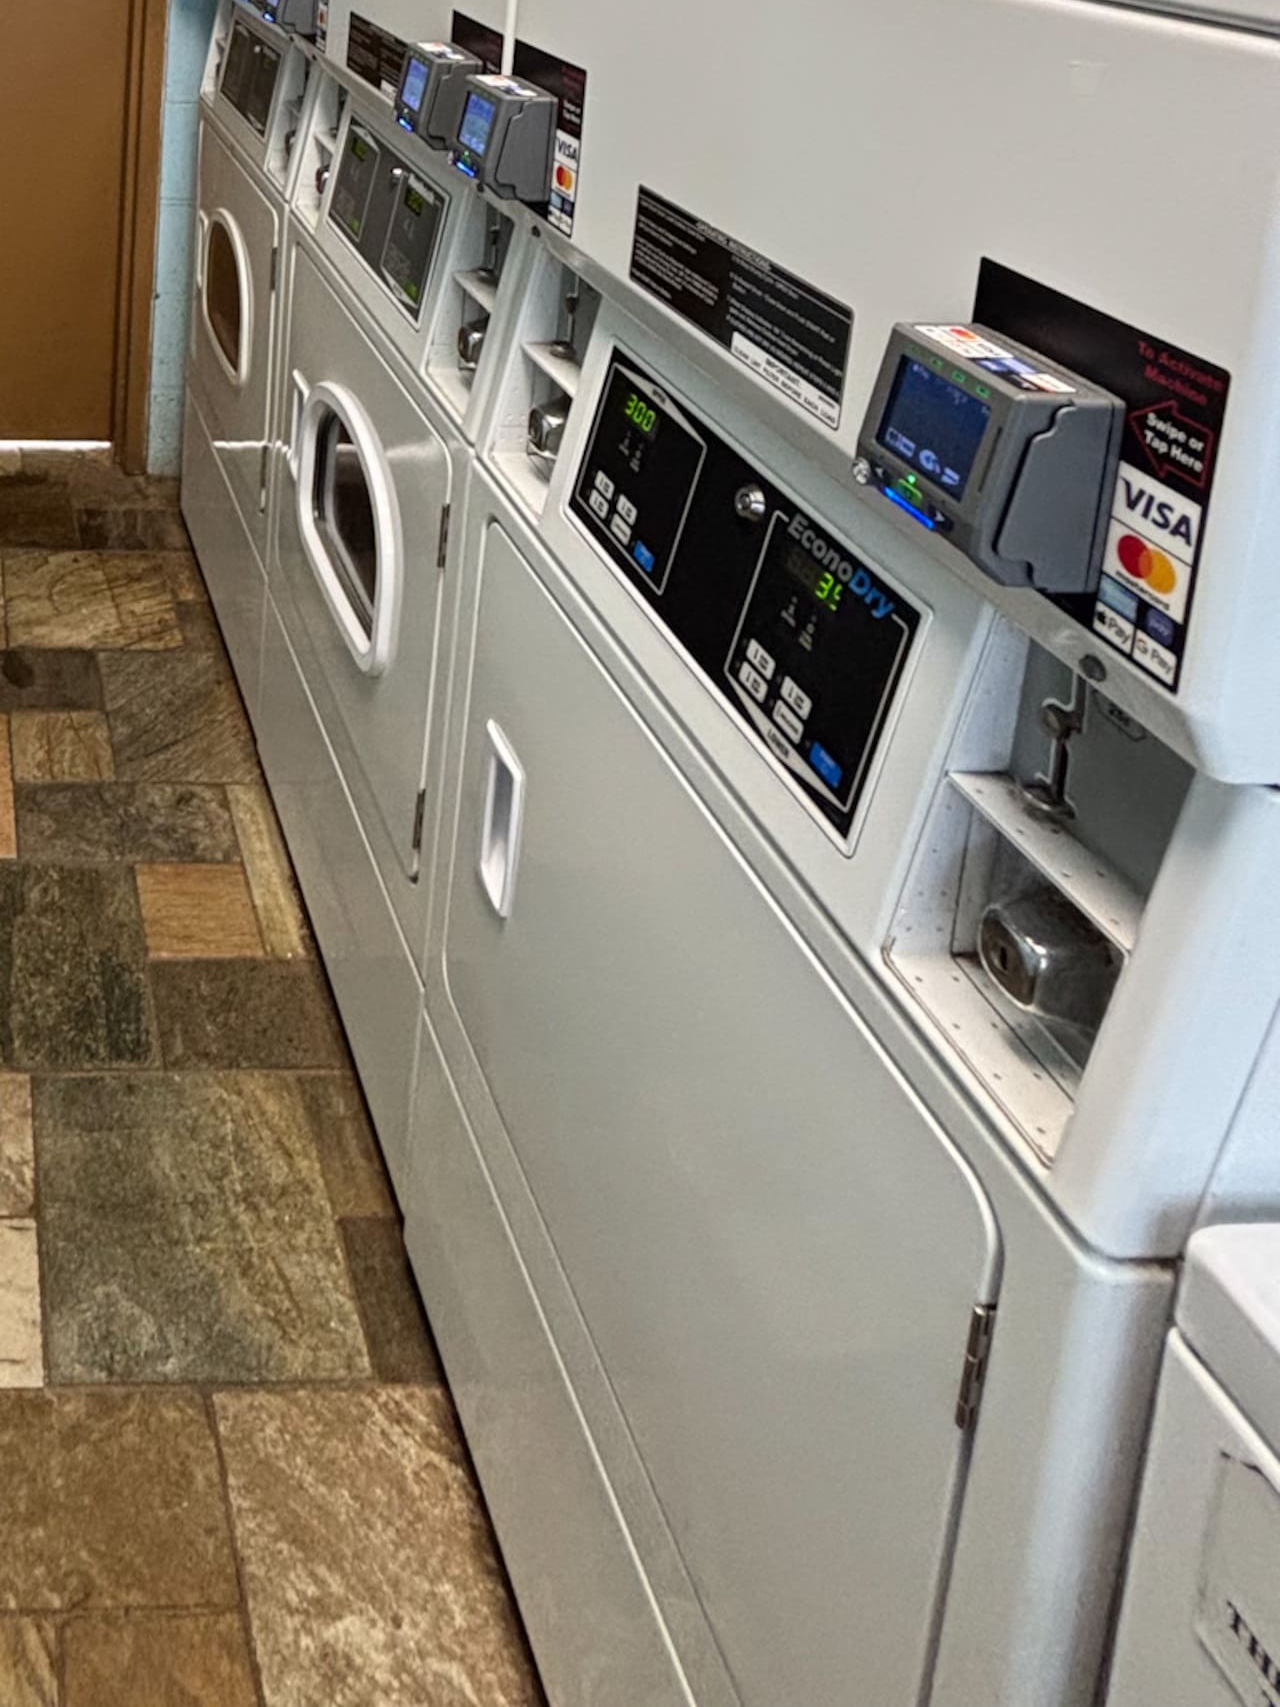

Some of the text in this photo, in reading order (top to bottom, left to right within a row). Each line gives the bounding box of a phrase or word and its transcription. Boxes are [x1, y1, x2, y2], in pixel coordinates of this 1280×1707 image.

[556, 139, 579, 161] VISA
[1138, 341, 1224, 391] To Activate
[1144, 365, 1208, 406] Machine
[625, 394, 657, 433] 300
[1147, 412, 1204, 452] Swipe or
[1144, 429, 1203, 472] Tap Here
[1121, 477, 1192, 547] VISA
[787, 513, 896, 619] EconoDry
[1107, 617, 1131, 644] Pay
[1150, 648, 1173, 674] Pay
